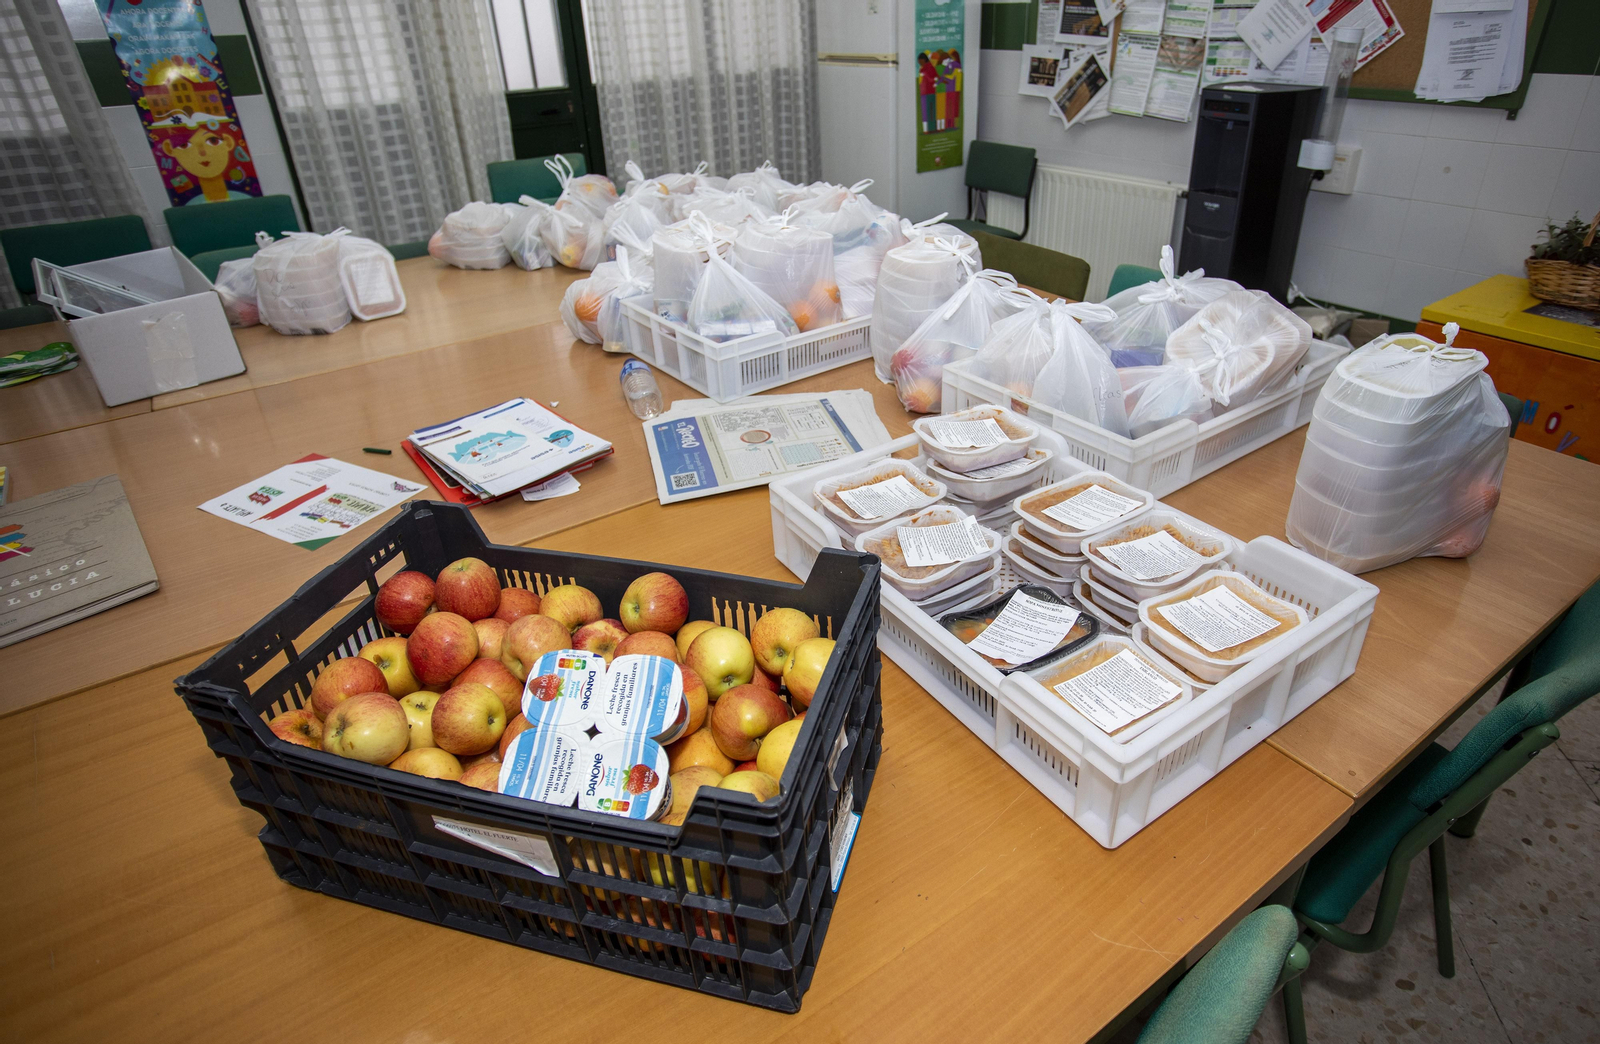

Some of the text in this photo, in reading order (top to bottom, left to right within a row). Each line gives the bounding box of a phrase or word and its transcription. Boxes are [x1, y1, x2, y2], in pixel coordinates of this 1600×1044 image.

[0, 558, 86, 592] ásico
[606, 671, 621, 715] Leche fresca
[616, 674, 628, 715] recogida en
[620, 662, 638, 727] granjas familiares
[656, 697, 667, 717] 11/04
[516, 753, 527, 772] 11/04
[550, 736, 563, 766] granjas
[552, 749, 568, 792] recogida en
[560, 748, 577, 794] Leche fresca
[604, 766, 612, 787] sabor
[610, 767, 619, 788] fresa
